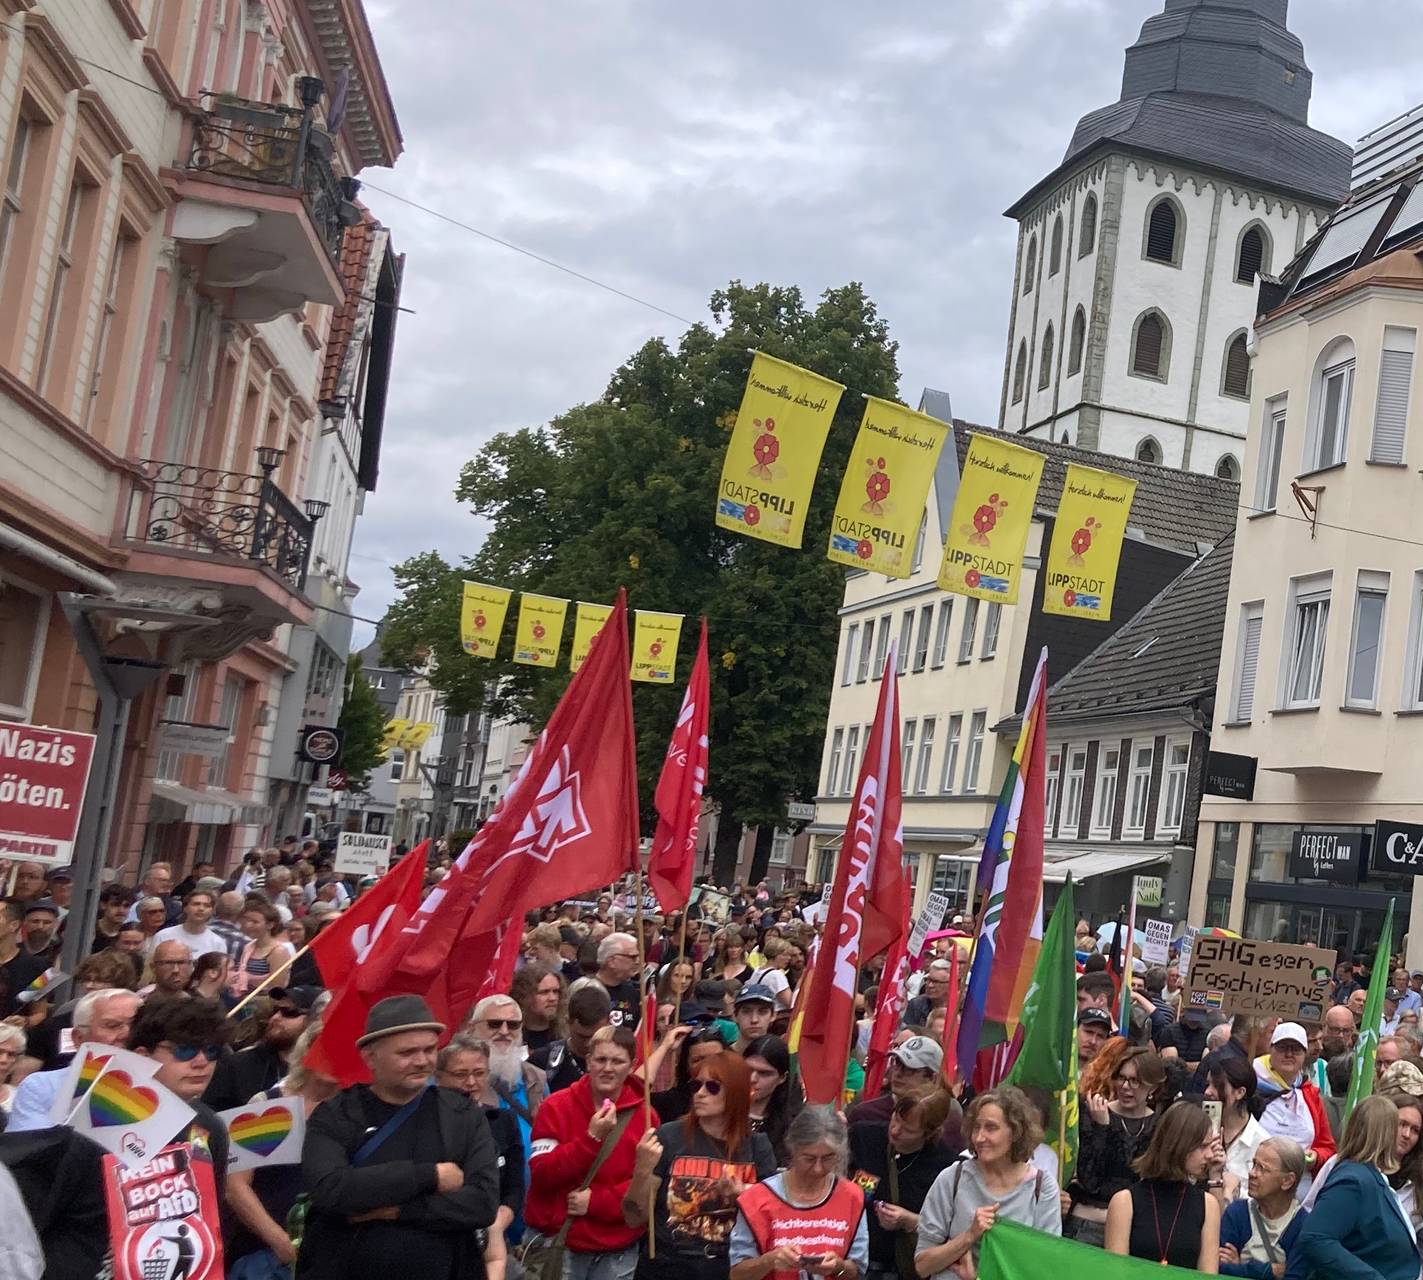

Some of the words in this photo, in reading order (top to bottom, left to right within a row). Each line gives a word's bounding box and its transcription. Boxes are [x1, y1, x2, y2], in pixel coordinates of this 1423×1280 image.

[968, 451, 995, 472] Herzlich
[996, 462, 1033, 481] willkommen!
[946, 549, 1014, 576] LIPPSTADT
[1048, 572, 1105, 594] LIPPSTADT
[0, 729, 76, 766] Nazis
[1299, 835, 1338, 860] PERFECT
[1337, 846, 1351, 860] MAN
[1146, 930, 1170, 941] GEGEN
[1148, 921, 1171, 933] OMAS
[1145, 937, 1168, 947] RECHTS
[1190, 963, 1324, 1002] Faschismus
[128, 1173, 190, 1207] BOCK
[127, 1205, 157, 1221] auf
[157, 1188, 198, 1220] AfD
